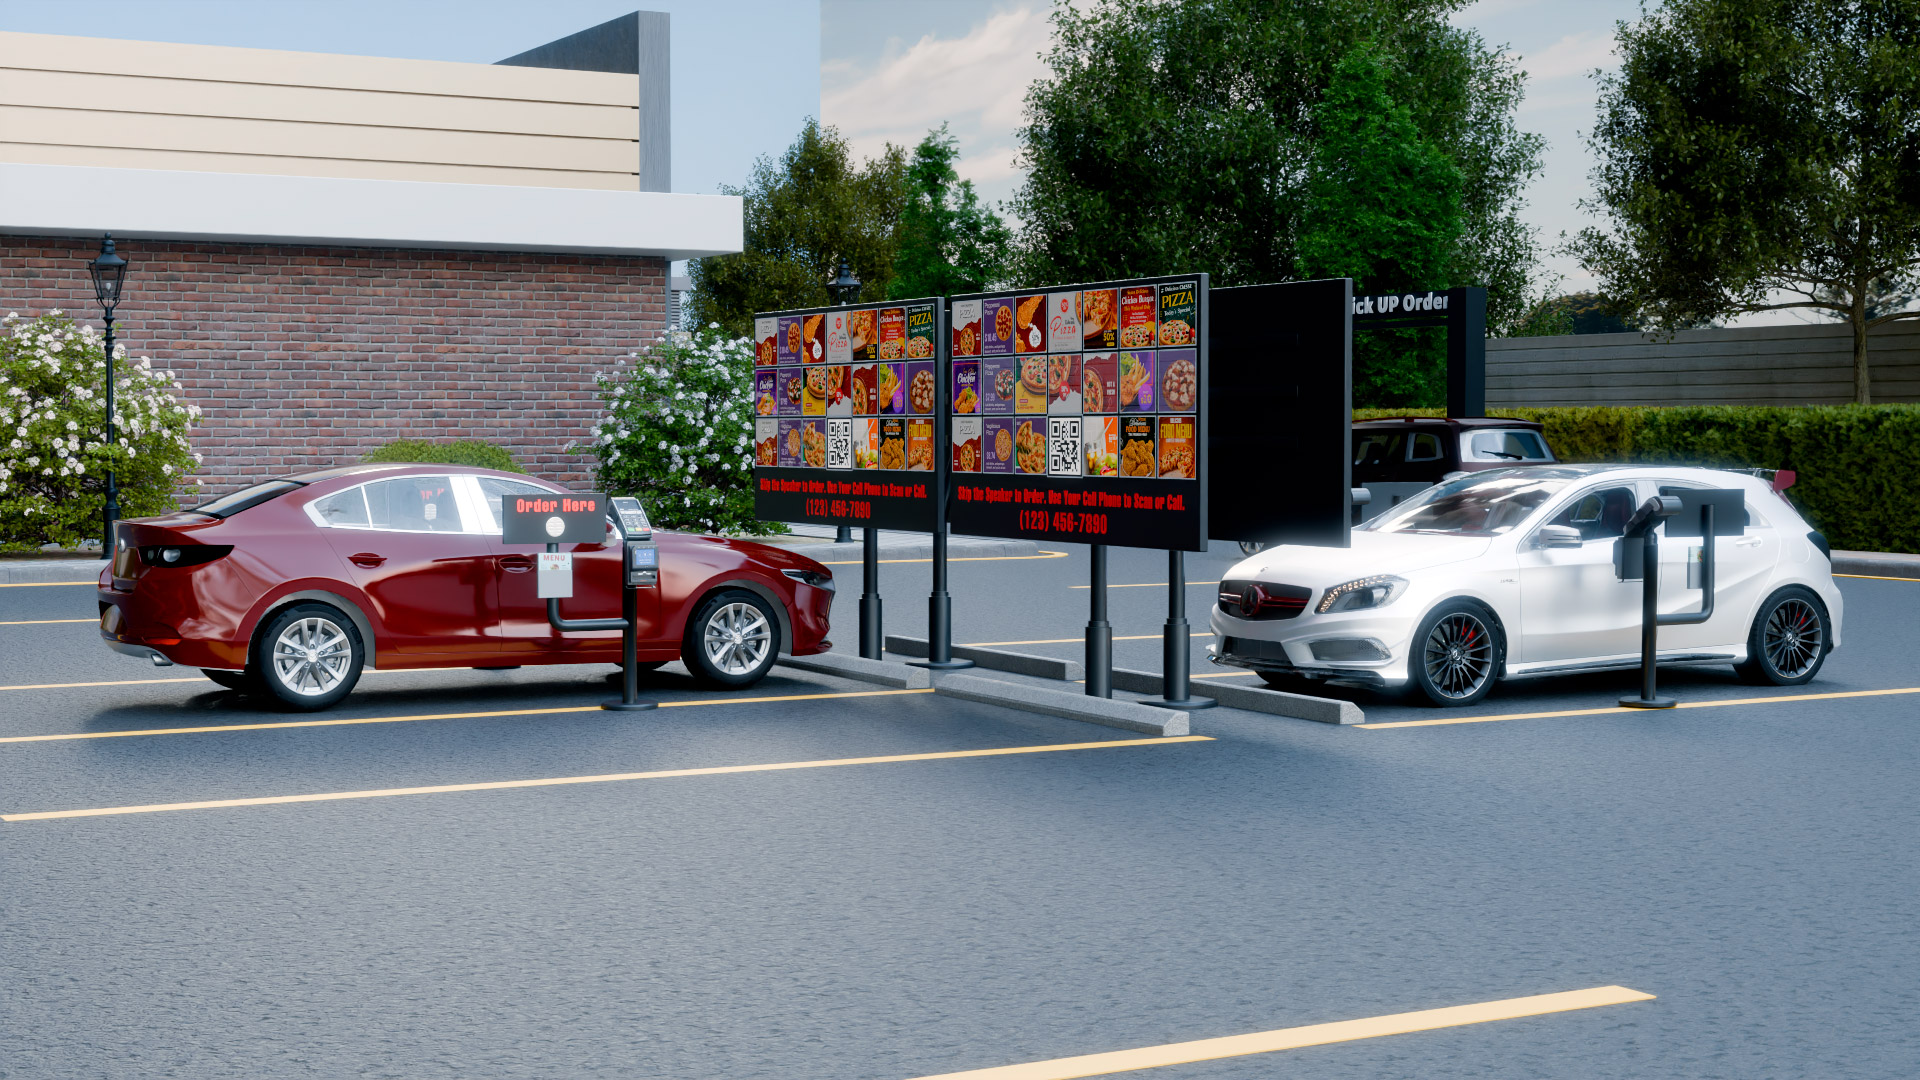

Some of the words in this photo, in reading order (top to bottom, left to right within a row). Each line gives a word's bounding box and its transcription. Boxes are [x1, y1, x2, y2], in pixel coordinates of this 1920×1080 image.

[1162, 291, 1193, 308] PIZZA
[1352, 296, 1374, 314] ick
[1377, 295, 1399, 313] UP
[1402, 292, 1448, 311] Order
[909, 312, 932, 326] PIZZA
[1103, 332, 1115, 341] 50%
[1160, 424, 1175, 438] FOOD
[1176, 424, 1192, 438] MENU
[781, 479, 801, 493] Speaker
[803, 481, 808, 492] to
[809, 480, 826, 493] Order.
[827, 481, 837, 494] Use
[839, 482, 851, 495] Your
[853, 482, 863, 495] Cell
[864, 483, 881, 496] Phone
[882, 484, 888, 496] to
[890, 483, 904, 497] Scan
[905, 486, 912, 498] or
[914, 485, 927, 498] Call.
[516, 498, 557, 513] Order
[563, 498, 595, 512] Here
[958, 486, 971, 502] Skip
[973, 487, 984, 501] the
[986, 487, 1012, 503] Speaker
[1015, 489, 1021, 502] to
[1024, 489, 1046, 504] Order.
[1049, 490, 1061, 504] Use
[1064, 490, 1080, 505] Your
[1083, 491, 1097, 506] Cell
[1099, 492, 1121, 507] Phone
[1124, 494, 1131, 508] to
[1134, 493, 1152, 509] Scan
[1155, 497, 1165, 510] or
[1167, 495, 1185, 511] Call.
[806, 499, 828, 517] (123)
[830, 500, 870, 519] 456-7890
[1020, 510, 1049, 532] (123)
[1053, 512, 1107, 534] 456-7890
